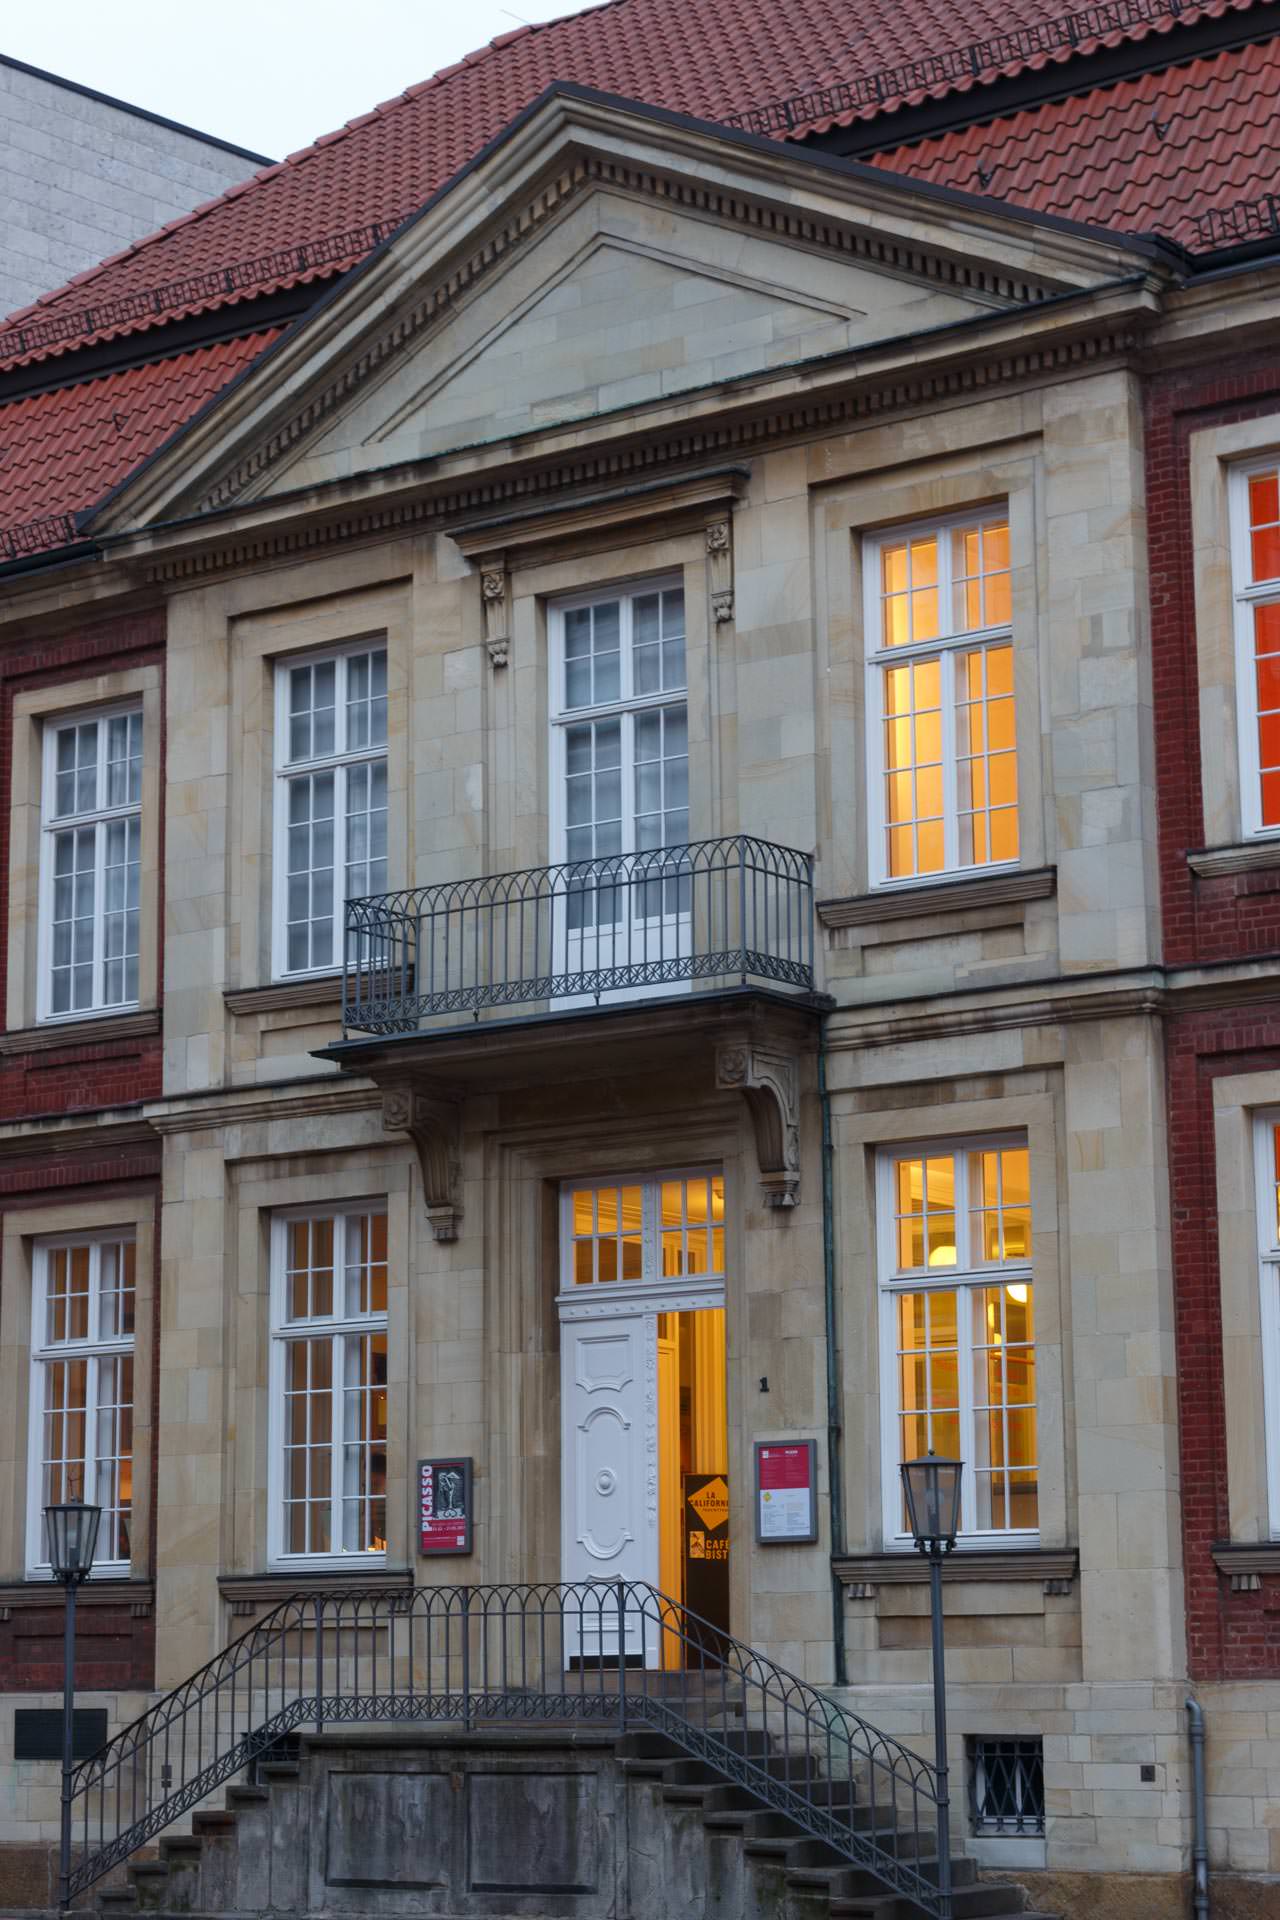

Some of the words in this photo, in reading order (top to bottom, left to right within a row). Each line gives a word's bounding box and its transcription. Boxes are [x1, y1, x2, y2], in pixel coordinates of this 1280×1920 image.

[759, 1376, 769, 1392] 1
[422, 1465, 433, 1531] PICASSO
[706, 1491, 716, 1499] LA
